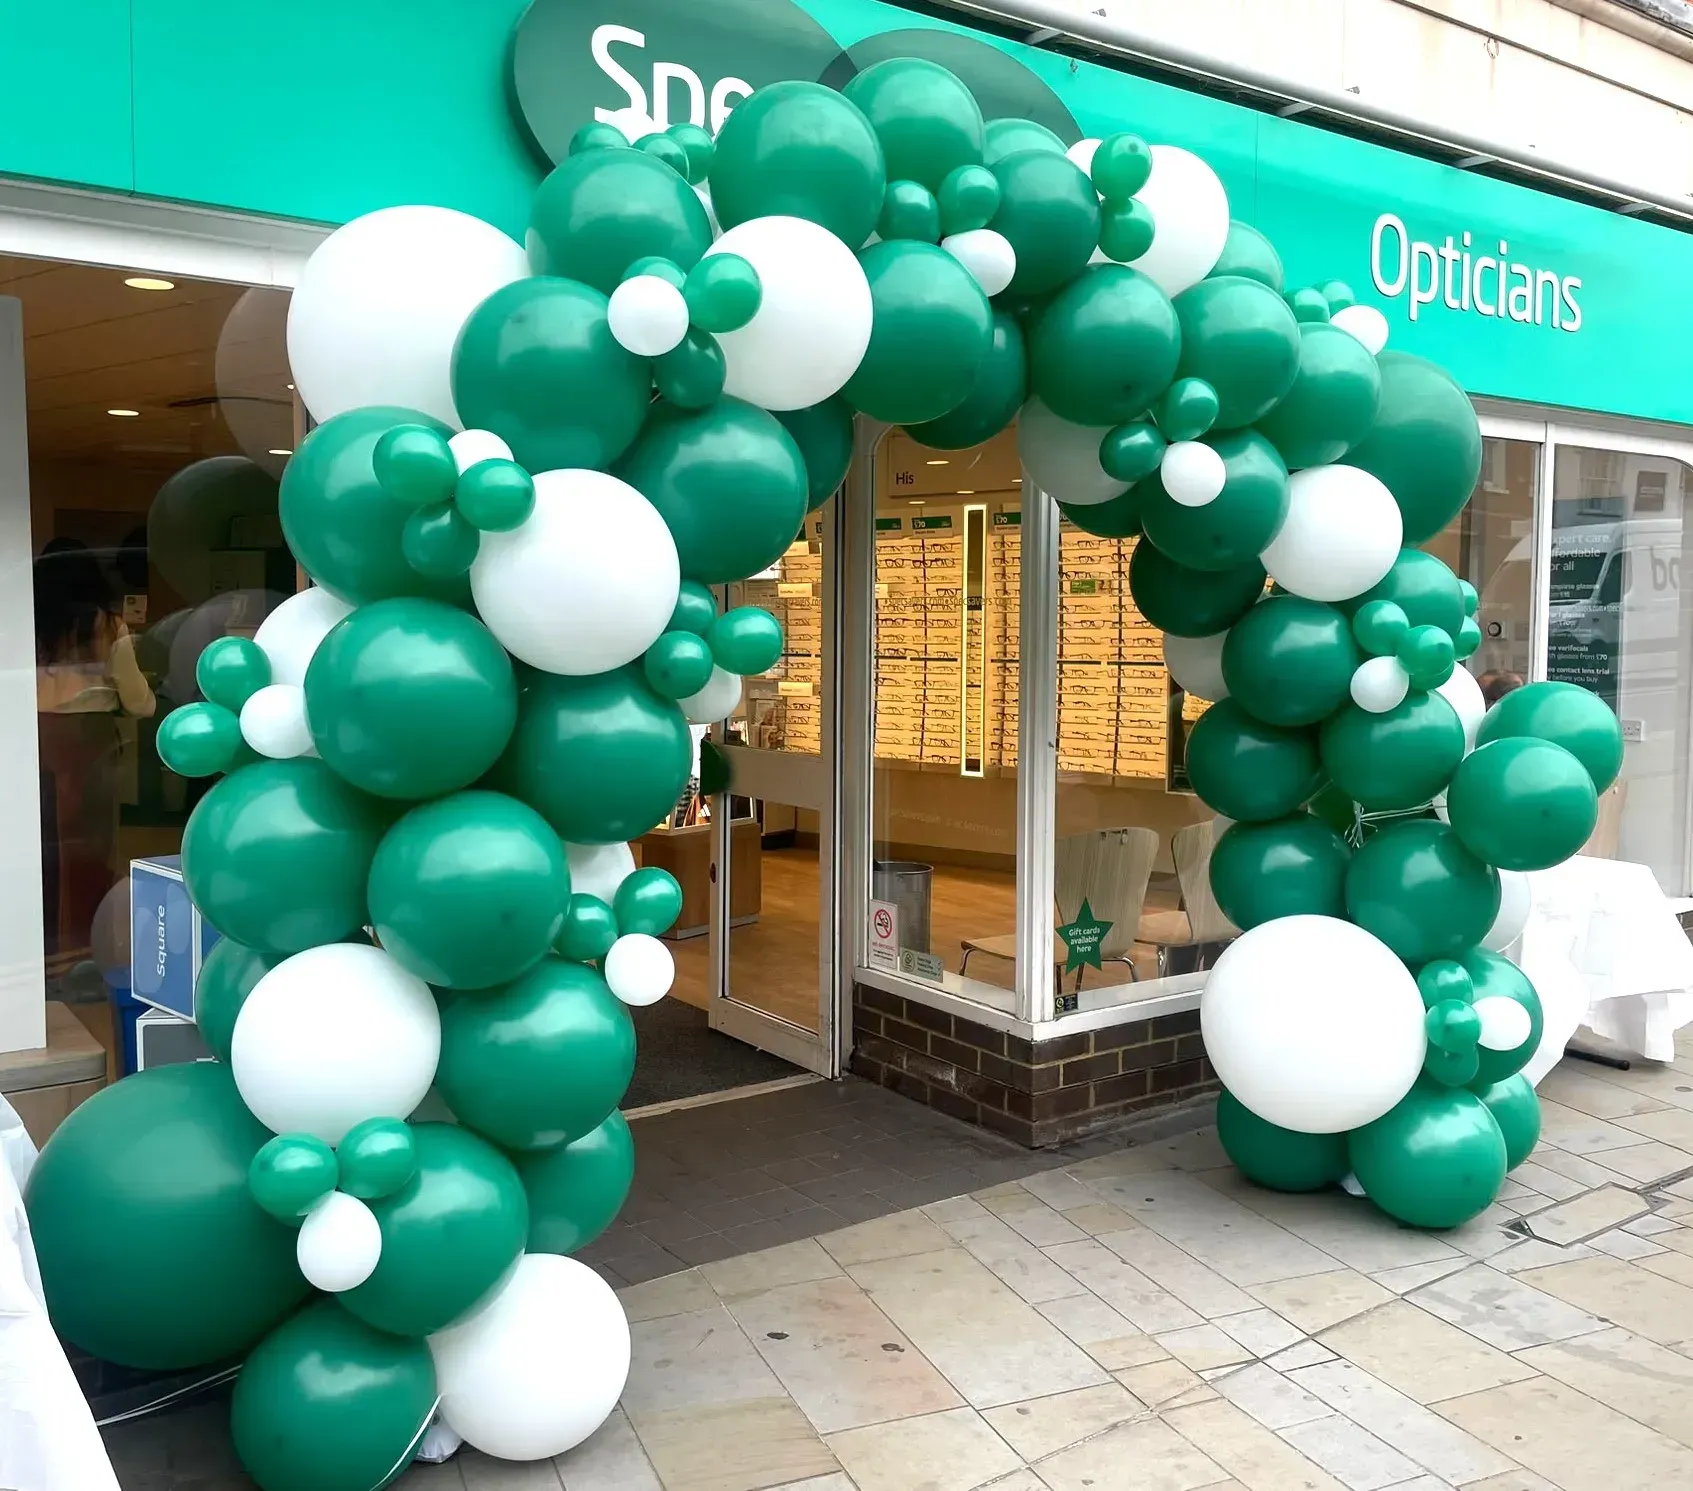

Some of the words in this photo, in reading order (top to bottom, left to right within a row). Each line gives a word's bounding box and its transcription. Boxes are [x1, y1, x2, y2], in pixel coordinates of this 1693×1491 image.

[1371, 213, 1582, 332] Opticians
[896, 472, 914, 485] His
[1069, 927, 1082, 937] Gift
[1083, 926, 1100, 935] cards
[157, 904, 166, 977] Square
[1071, 935, 1099, 945] available
[1077, 945, 1092, 953] here
